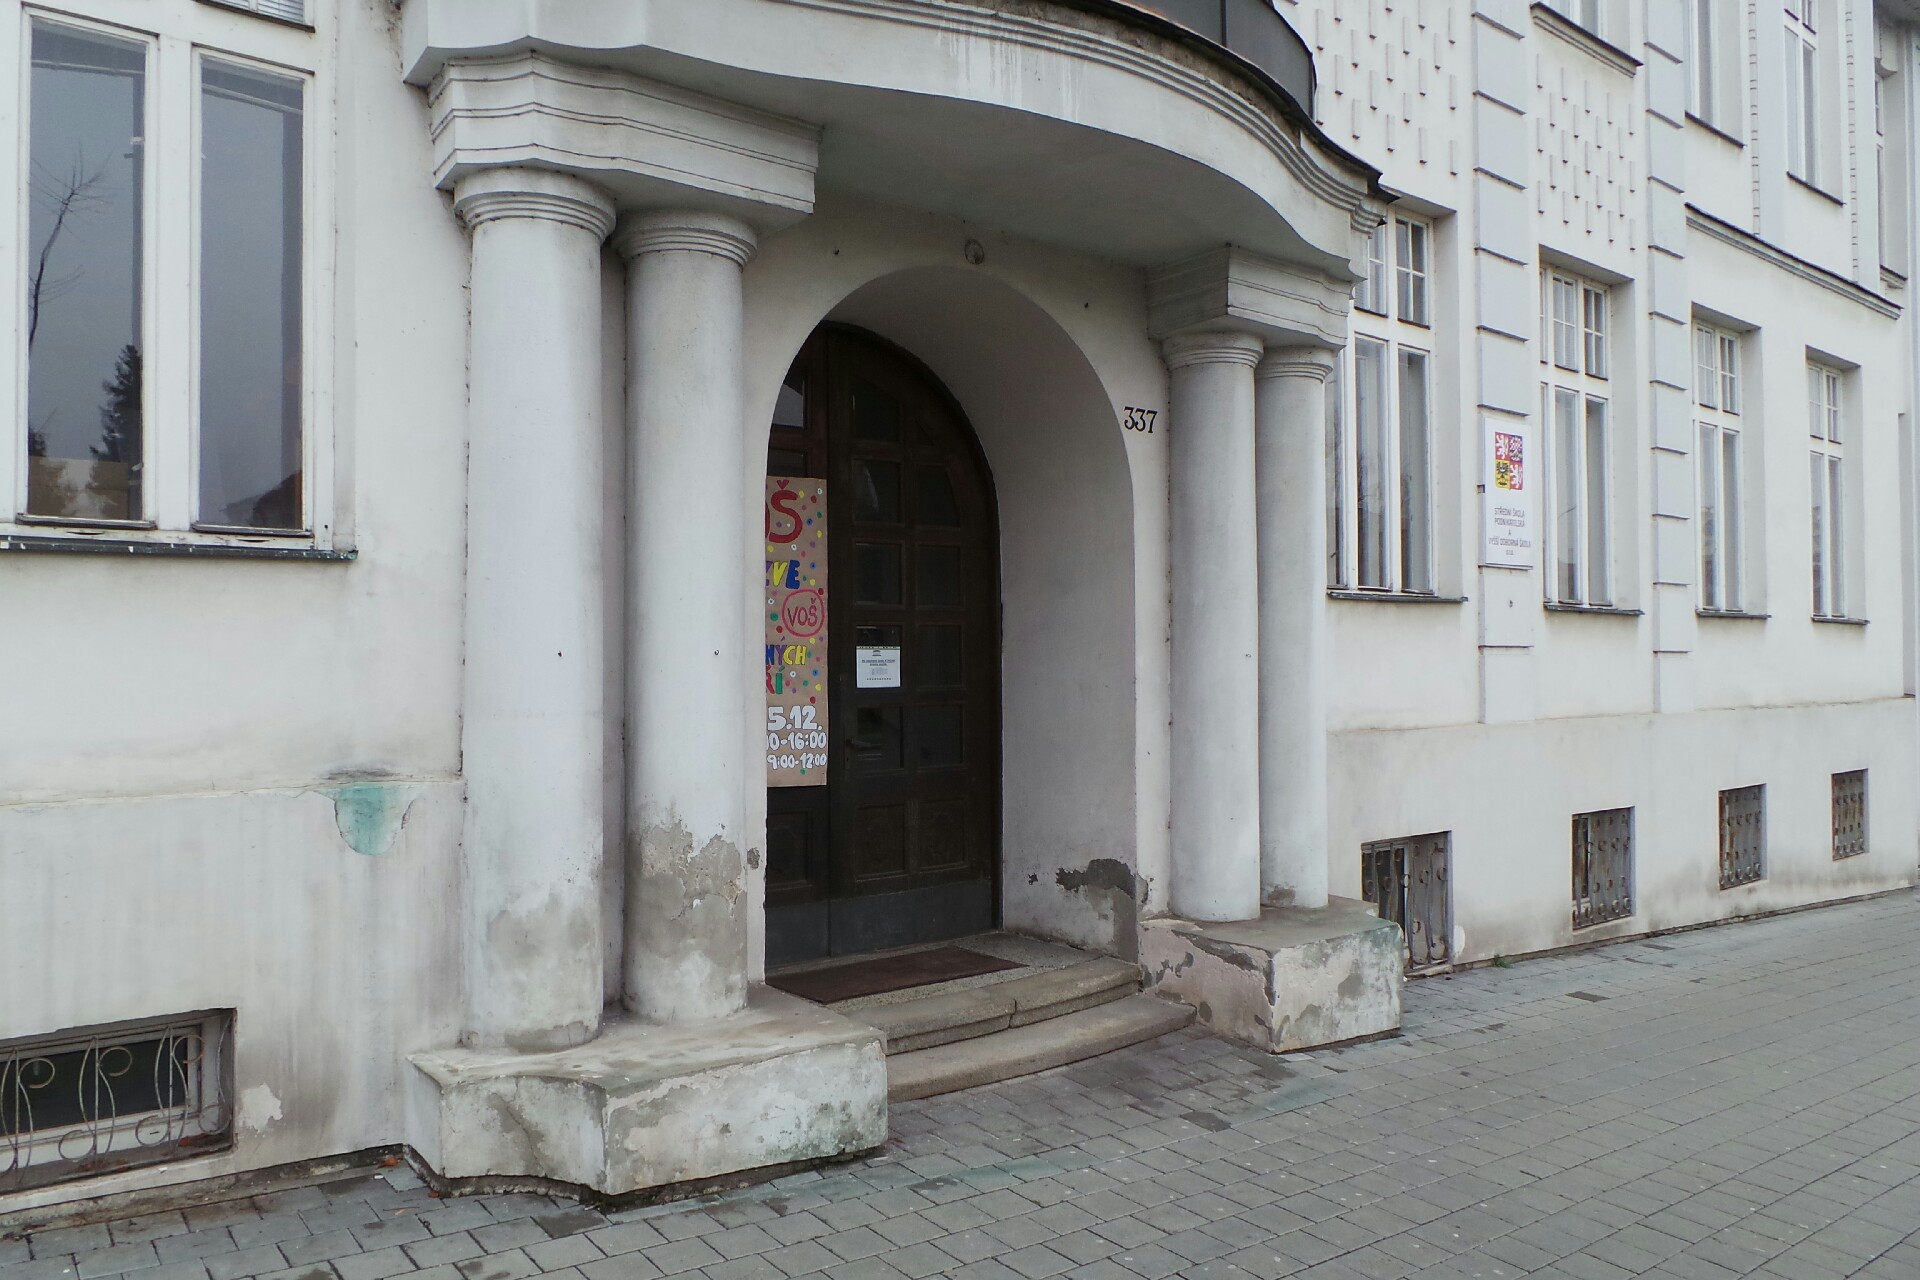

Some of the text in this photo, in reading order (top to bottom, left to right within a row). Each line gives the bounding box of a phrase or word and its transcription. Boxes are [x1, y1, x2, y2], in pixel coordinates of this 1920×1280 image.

[1124, 406, 1158, 434] 337
[766, 479, 803, 543] Š
[787, 597, 818, 627] VOŠ
[767, 731, 827, 750] 0-16:00
